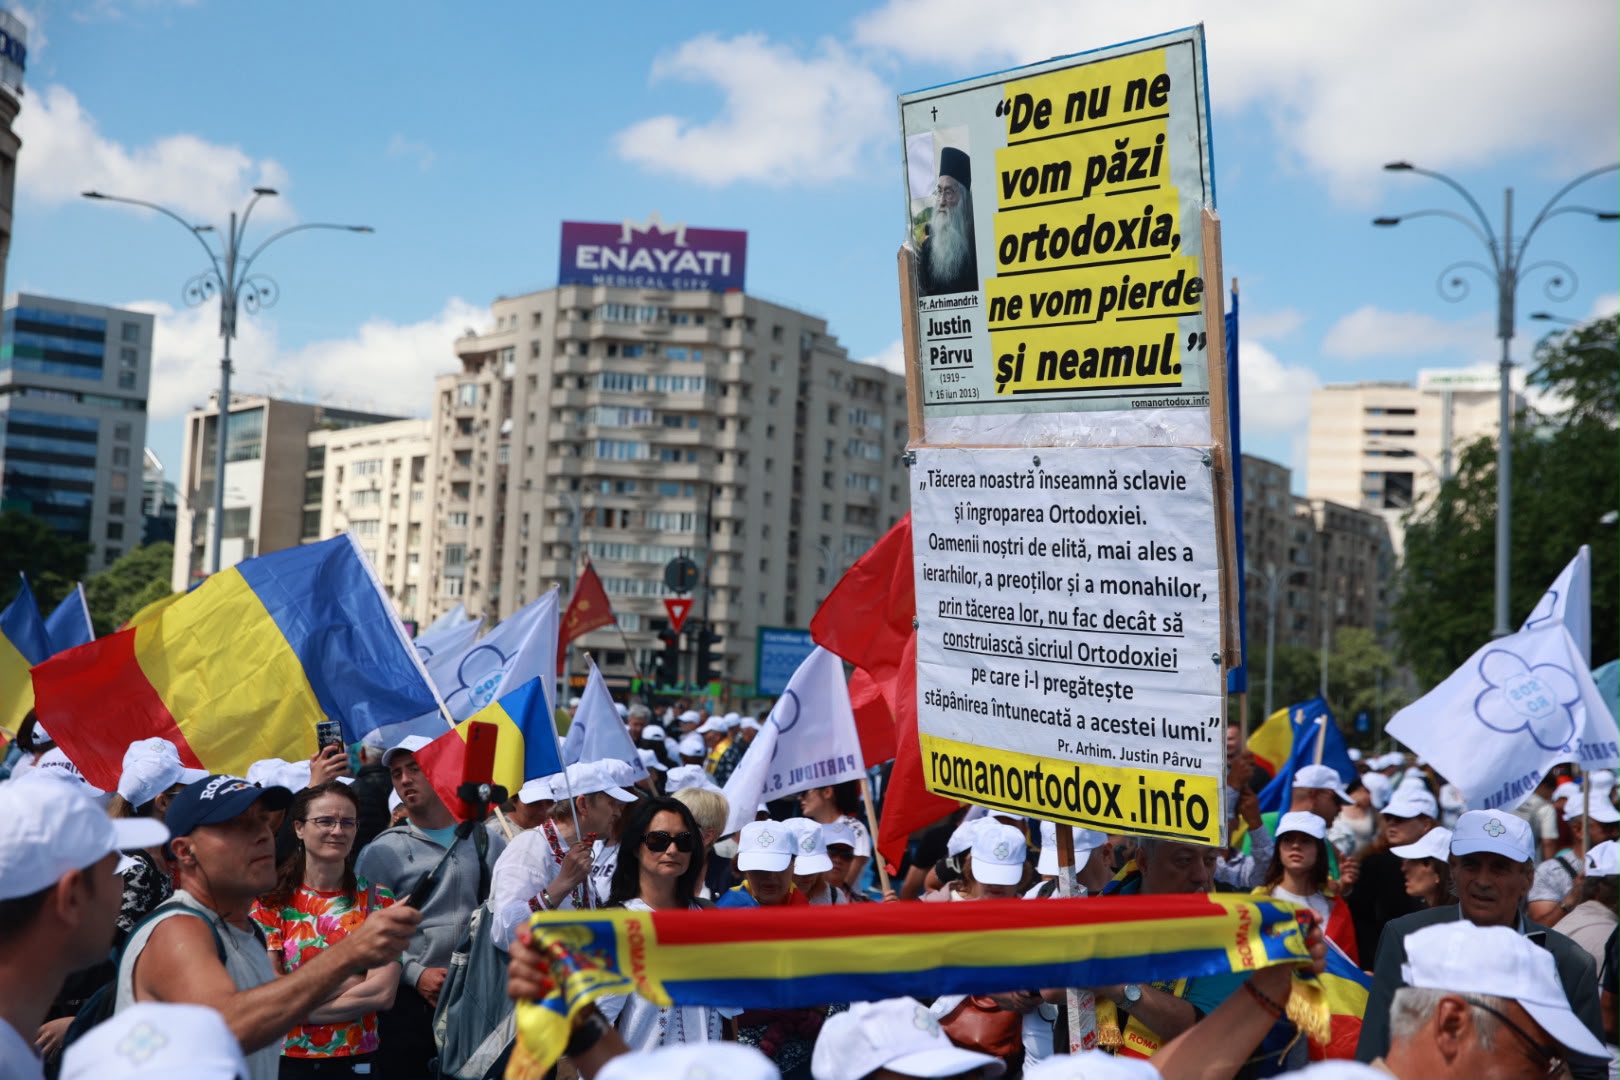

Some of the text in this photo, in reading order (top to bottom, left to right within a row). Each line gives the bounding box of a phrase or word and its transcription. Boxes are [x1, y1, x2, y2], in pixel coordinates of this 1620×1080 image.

[995, 73, 1171, 135] “De nu ne
[1001, 133, 1165, 200] vom păzi
[998, 204, 1181, 266] ortodoxia,
[575, 244, 732, 276] ENAYATI
[592, 273, 710, 291] MEDICAL CITY
[988, 269, 1205, 323] ne vom pierde
[927, 315, 971, 337] Justin
[930, 344, 973, 366] Pârvu
[995, 342, 1027, 394] și
[936, 389, 944, 400] 16
[946, 389, 957, 399] iun
[959, 387, 980, 400] 2013)
[919, 469, 1187, 491] „Tăcerea noastră înseamnă sclavie
[954, 502, 1147, 526] și îngroparea Ortodoxiei.
[928, 533, 1194, 562] Oamenii noștri de elită, mai ales a
[923, 563, 1208, 602] ierarhilor, a preoților și a monahilor,
[939, 597, 1184, 633] prin tăcerea lor, nu fac decât să
[943, 629, 1178, 669] construiască sicriul Ortodoxiei
[971, 667, 1134, 704] pe care i-l pregătește
[924, 688, 1220, 743] stăpânirea întunecată a acestei lumi.”
[1057, 738, 1202, 770] Pr. Arhim. Justin Pârvu
[1128, 1032, 1159, 1051] ROMA
